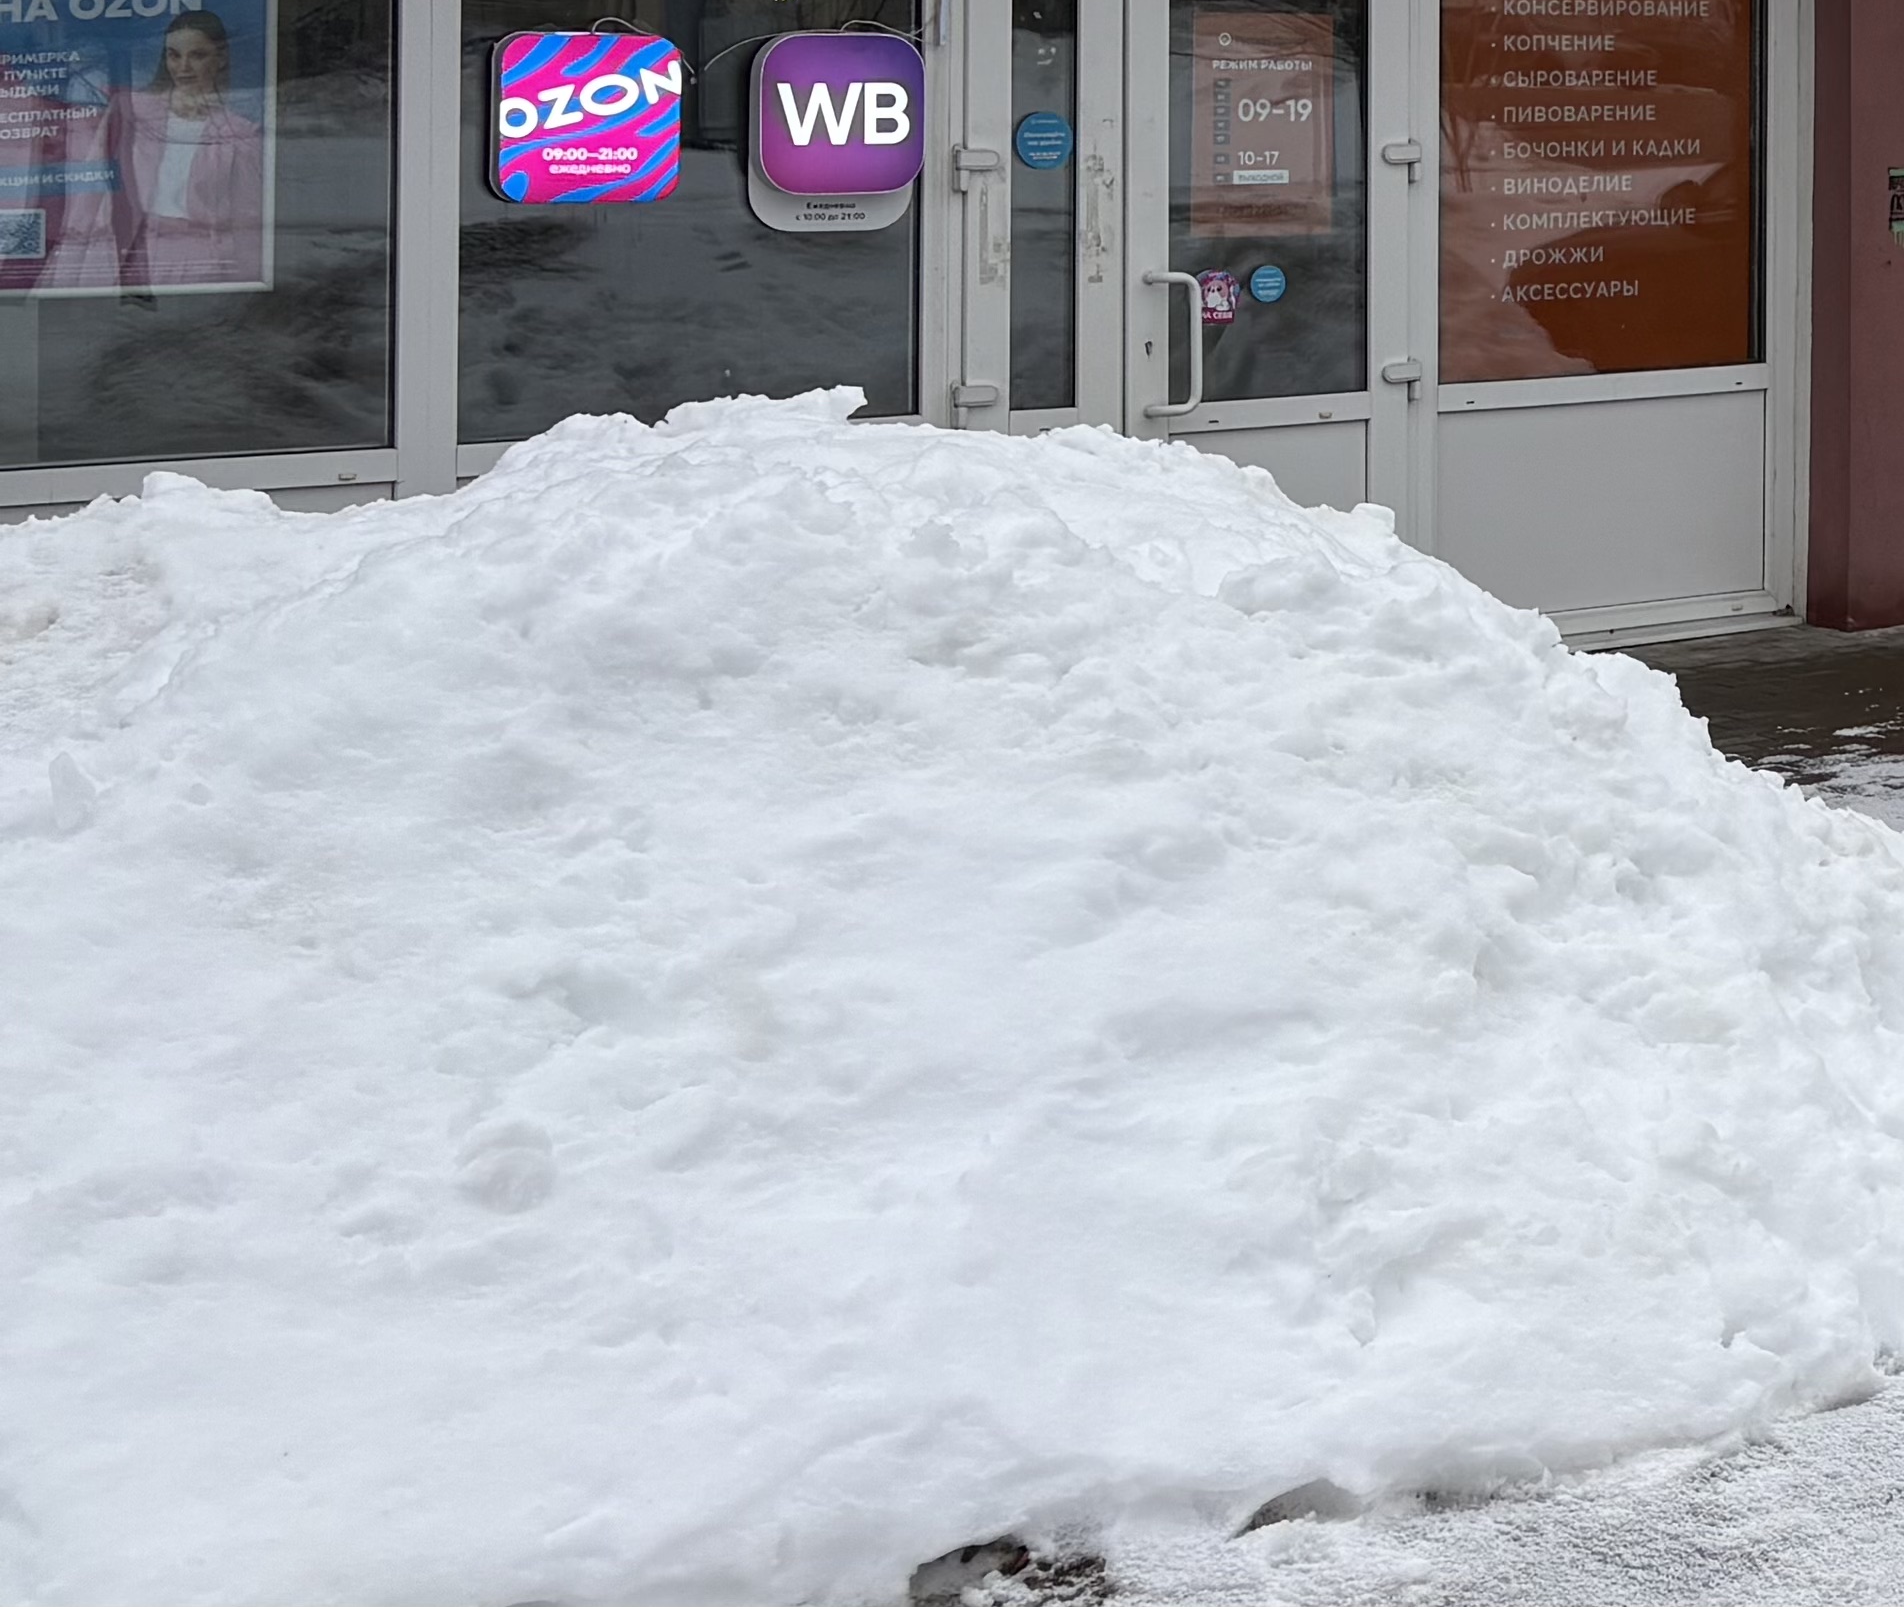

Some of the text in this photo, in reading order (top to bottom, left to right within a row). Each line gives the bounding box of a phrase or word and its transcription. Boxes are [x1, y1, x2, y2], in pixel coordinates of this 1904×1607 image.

[1503, 34, 1615, 51] КОПЧЕНИЕ
[0, 50, 80, 65] РИМЕРКА
[1213, 60, 1312, 71] РЕЖИМ РАБОТЫ
[4, 67, 67, 81] ПУНКТЕ
[1503, 69, 1657, 87] СЫРОВАРЕНИЕ
[0, 84, 59, 99] ЫДАЧИ
[500, 60, 682, 138] OZON
[777, 82, 910, 146] WB
[1238, 99, 1312, 122] 09-19
[1503, 105, 1656, 124] ПИВОВАРЕНИЕ
[1238, 151, 1279, 165] 10-17
[1503, 138, 1700, 159] БОЧОНКИ И КАДКИ
[549, 164, 631, 175] ежедневно
[1503, 175, 1632, 195] ВИНОДЕЛИЕ
[1503, 208, 1696, 230] КОМПЛЕКТУЮЩИЕ
[1503, 247, 1604, 268] ДРОЖЖИ
[1502, 280, 1639, 302] АКСЕССУАРЫ
